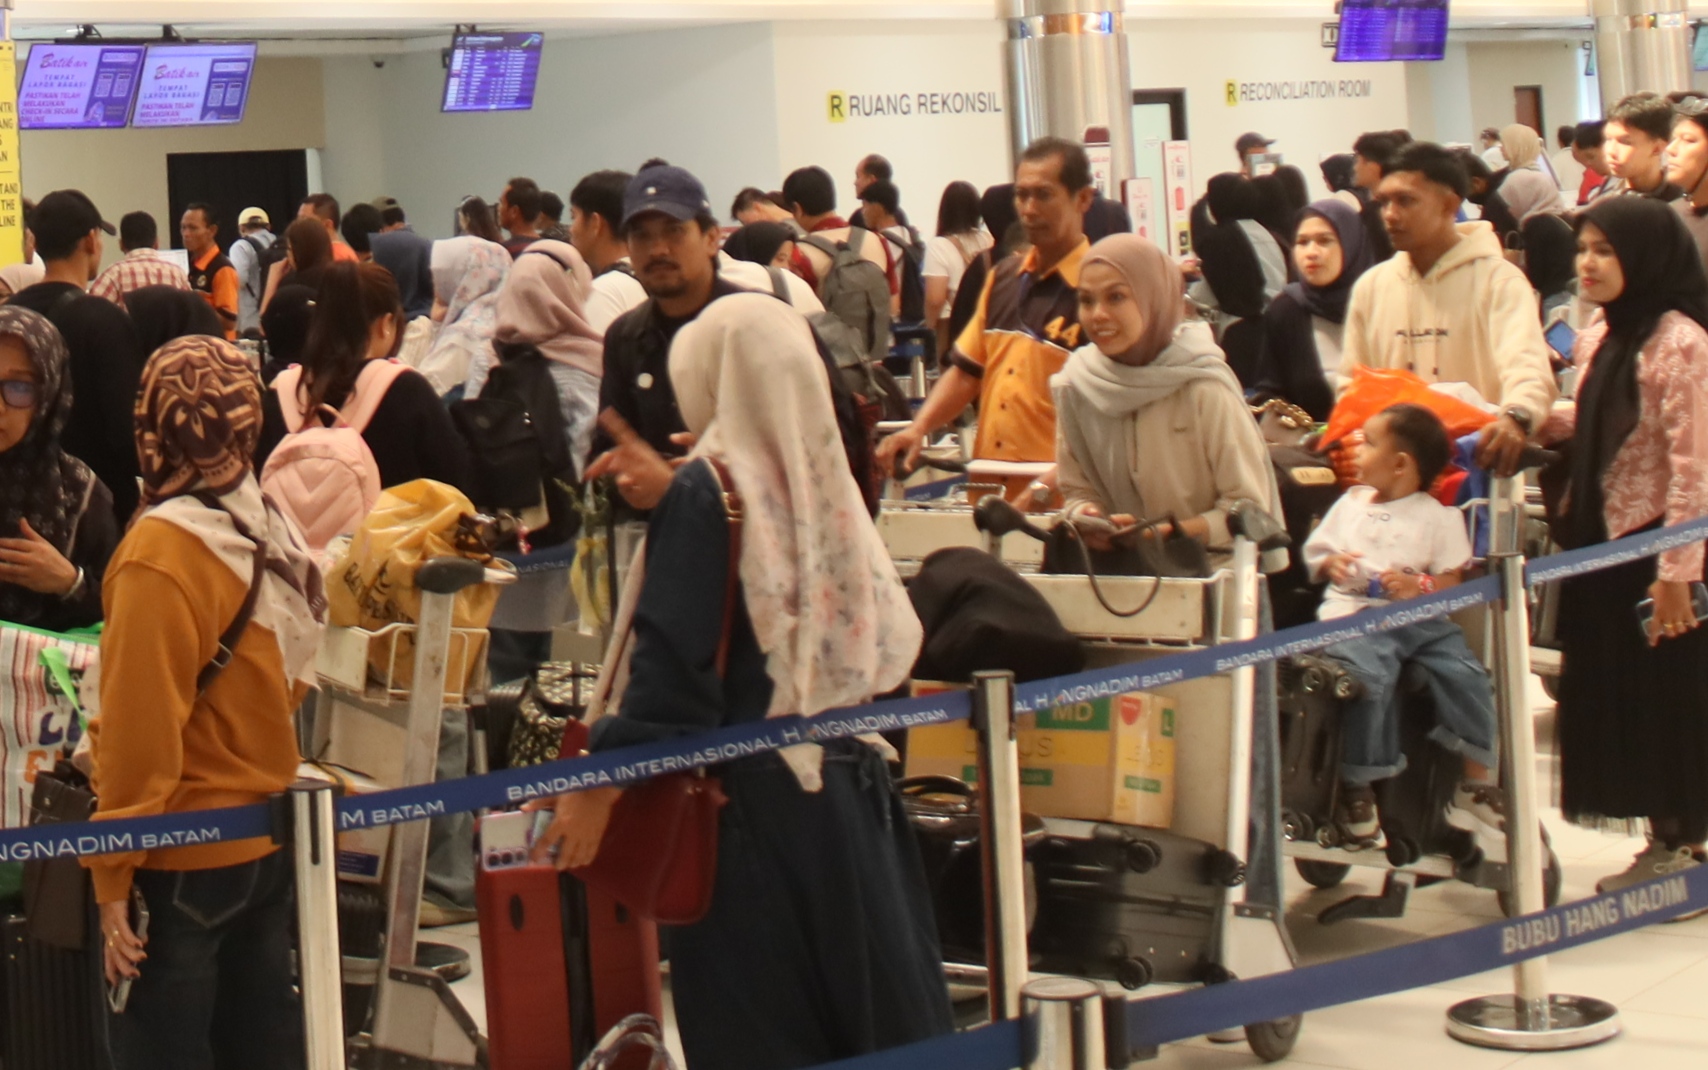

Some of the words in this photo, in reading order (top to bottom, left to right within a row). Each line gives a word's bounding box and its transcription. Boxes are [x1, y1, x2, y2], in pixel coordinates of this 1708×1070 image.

[40, 52, 73, 69] Batik
[154, 64, 187, 80] Batik
[1227, 82, 1237, 102] R
[1240, 81, 1336, 101] RECONCILIATION
[1338, 79, 1371, 98] ROOM
[831, 94, 844, 117] R
[849, 94, 911, 116] RUANG
[917, 92, 1002, 114] REKONSIL
[1, 199, 15, 211] THE
[1044, 315, 1082, 348] 44
[1215, 648, 1274, 672] BANDARA
[1275, 627, 1364, 657] INTERNASIONAL
[1142, 668, 1184, 689] BATAM
[507, 769, 612, 801] BANDARA
[614, 733, 779, 780] INTERNASIONAL
[900, 708, 948, 726] BATAM
[371, 799, 445, 824] BATAM
[141, 826, 221, 848] BATAM
[1501, 913, 1561, 955] BUBU
[1564, 897, 1620, 938] HANG
[1621, 875, 1689, 918] NADIM
